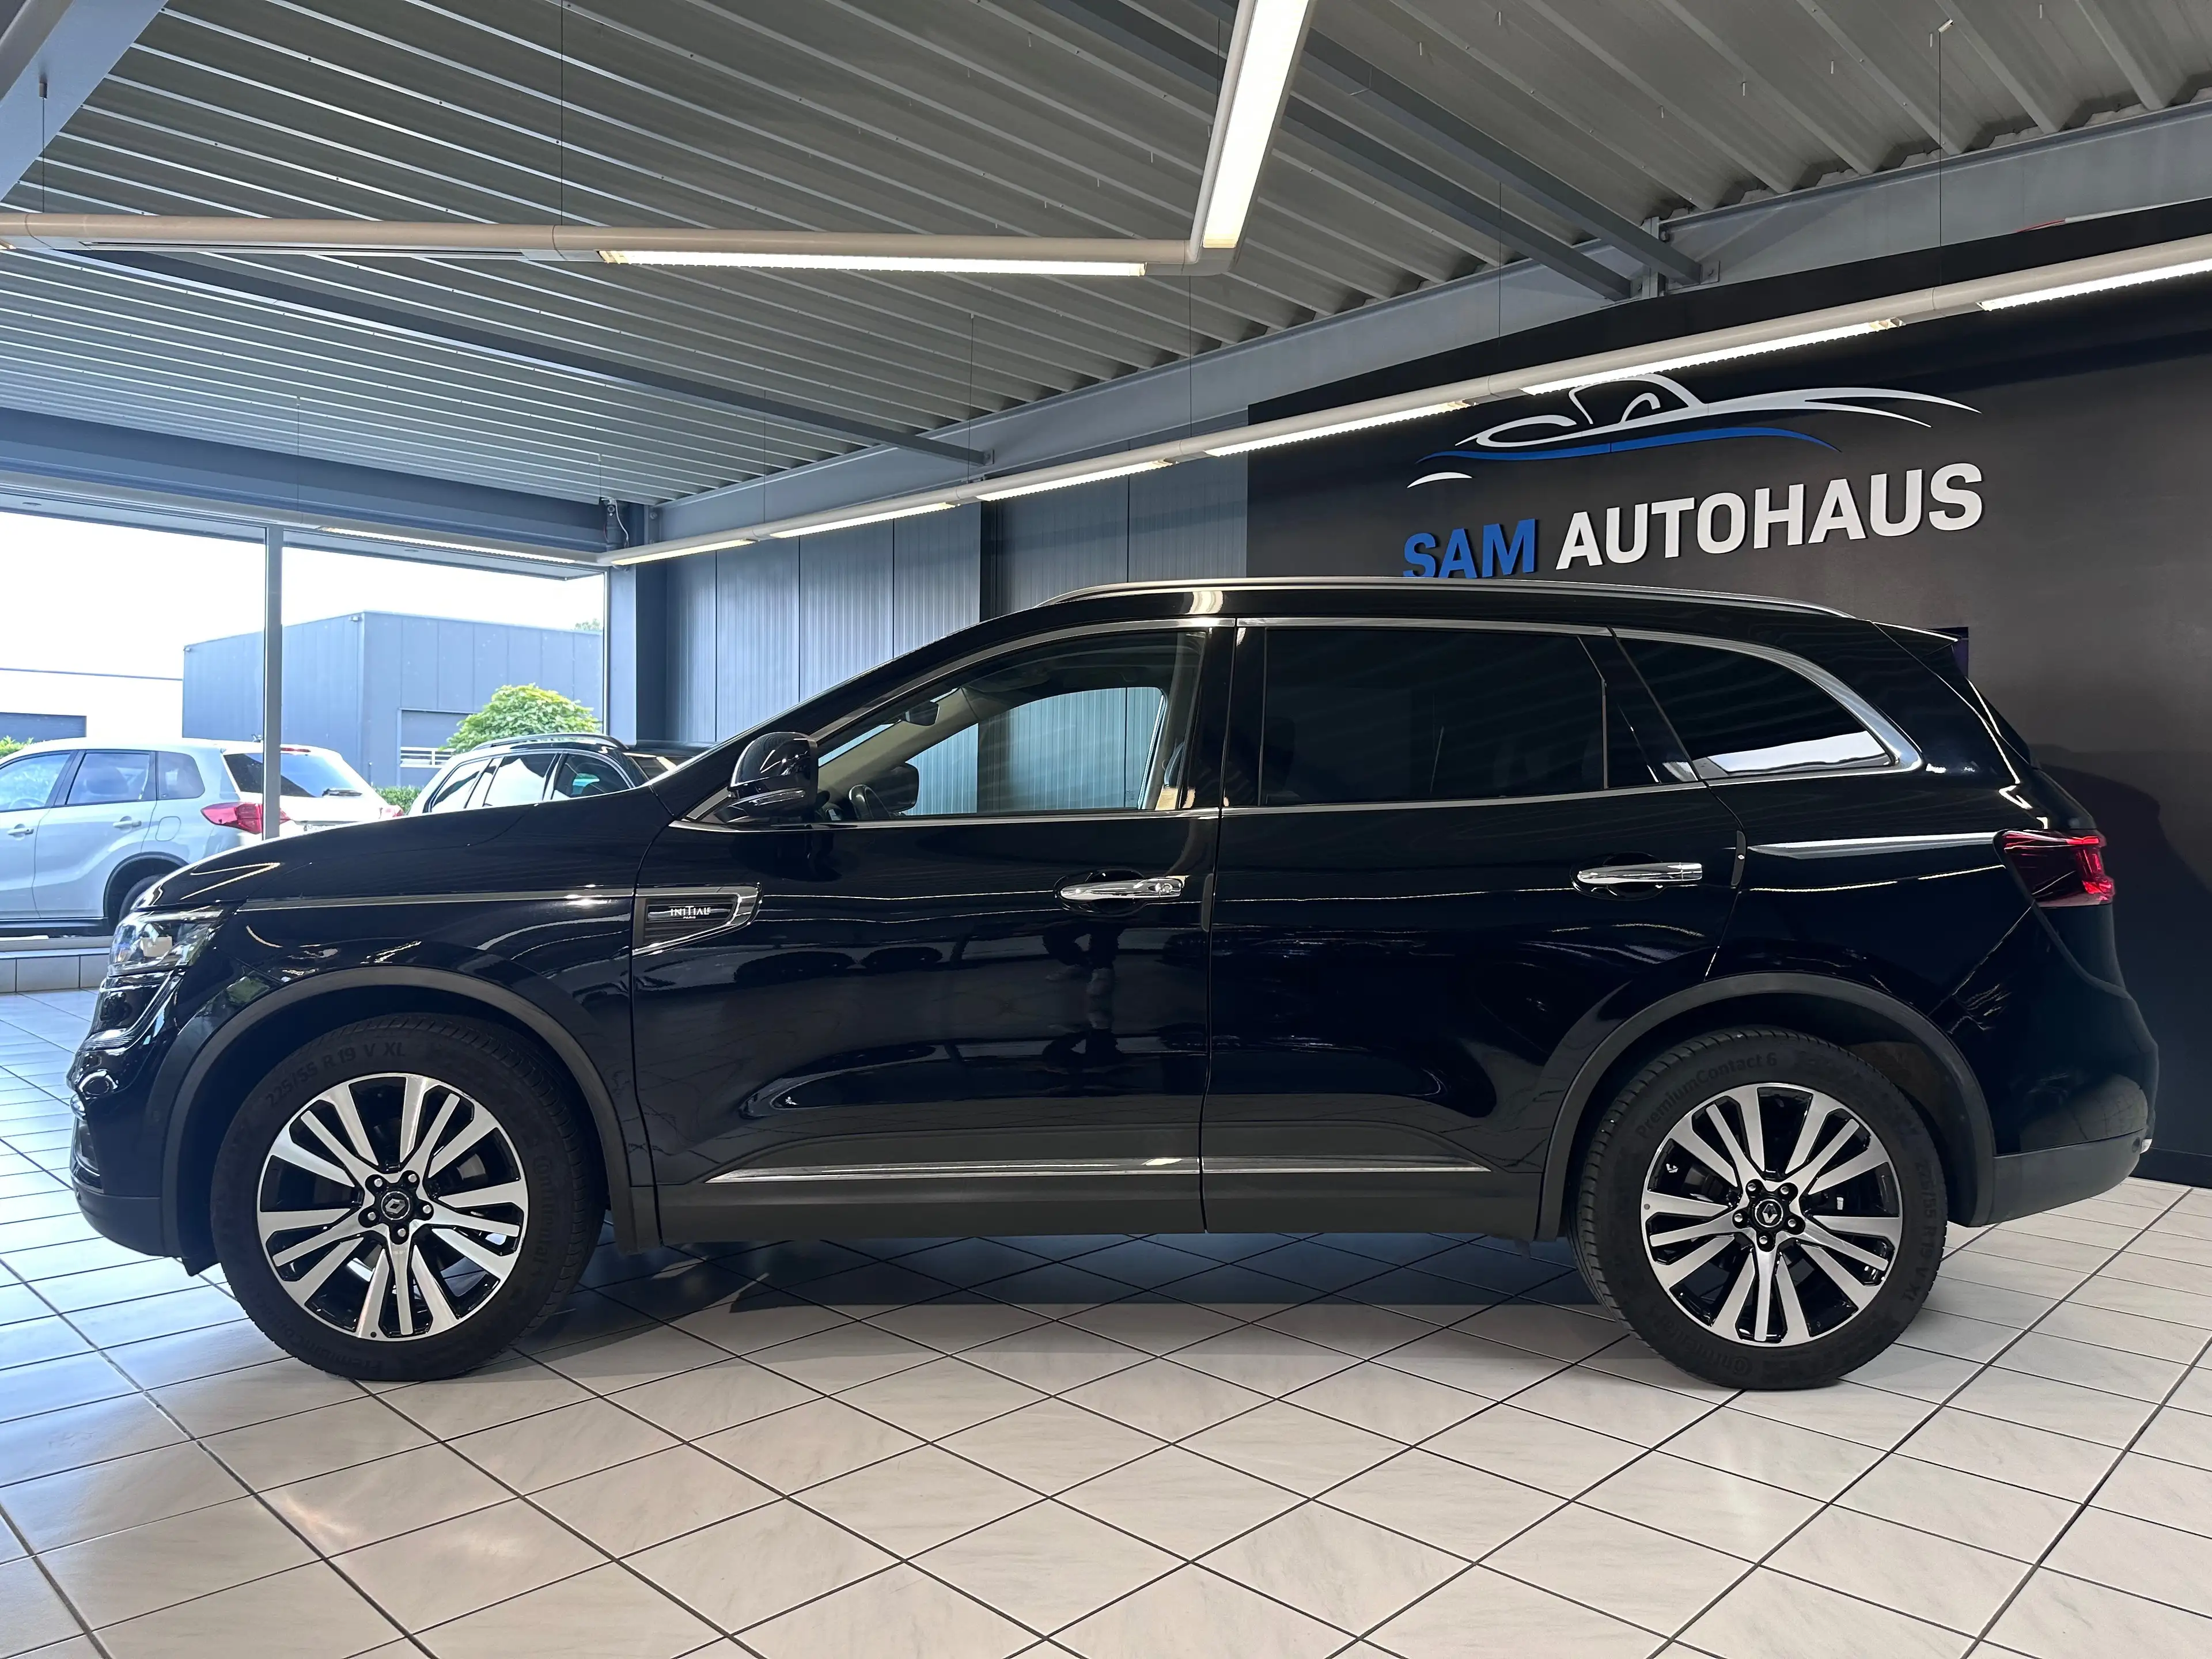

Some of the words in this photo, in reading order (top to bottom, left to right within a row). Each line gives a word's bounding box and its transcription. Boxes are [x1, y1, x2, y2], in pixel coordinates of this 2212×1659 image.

[1403, 518, 1536, 578] SAM
[1555, 463, 1983, 570] AUTOHAUS
[670, 905, 711, 916] INITIALE
[266, 1061, 317, 1108] 225/55
[321, 1054, 336, 1069] R
[338, 1047, 356, 1064] 19
[363, 1043, 376, 1058] V
[383, 1041, 406, 1057] XL
[1635, 1054, 1763, 1139] PremiumContact
[1766, 1051, 1778, 1067] 6
